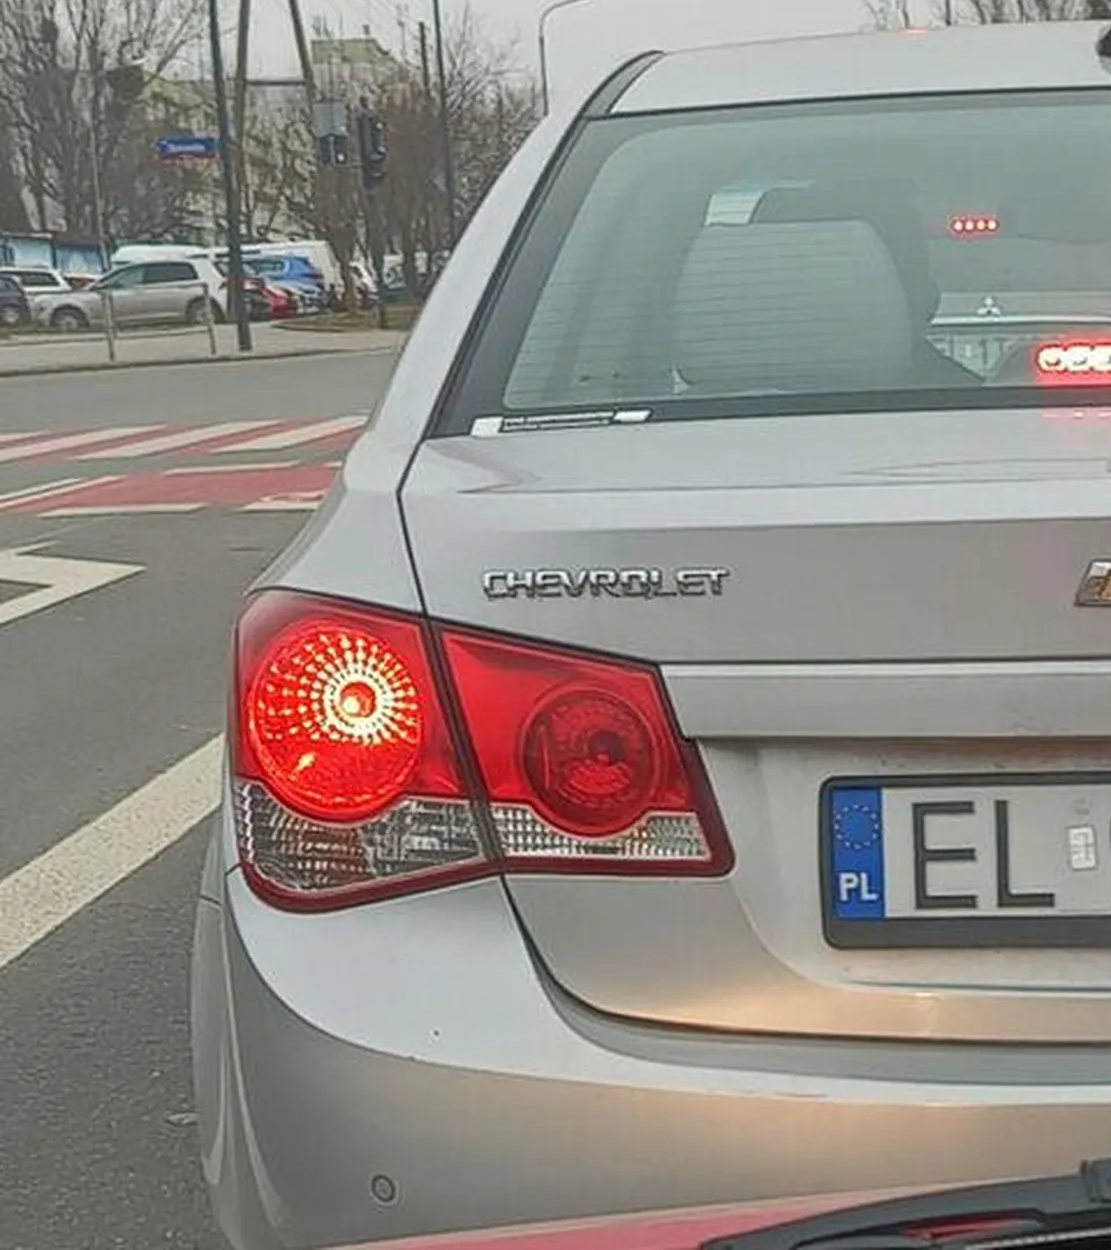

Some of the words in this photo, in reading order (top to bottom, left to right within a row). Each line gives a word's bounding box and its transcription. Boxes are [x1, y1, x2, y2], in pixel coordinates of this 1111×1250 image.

[484, 567, 730, 599] CHEVROLET
[912, 799, 1056, 910] EL
[838, 873, 879, 902] PL
